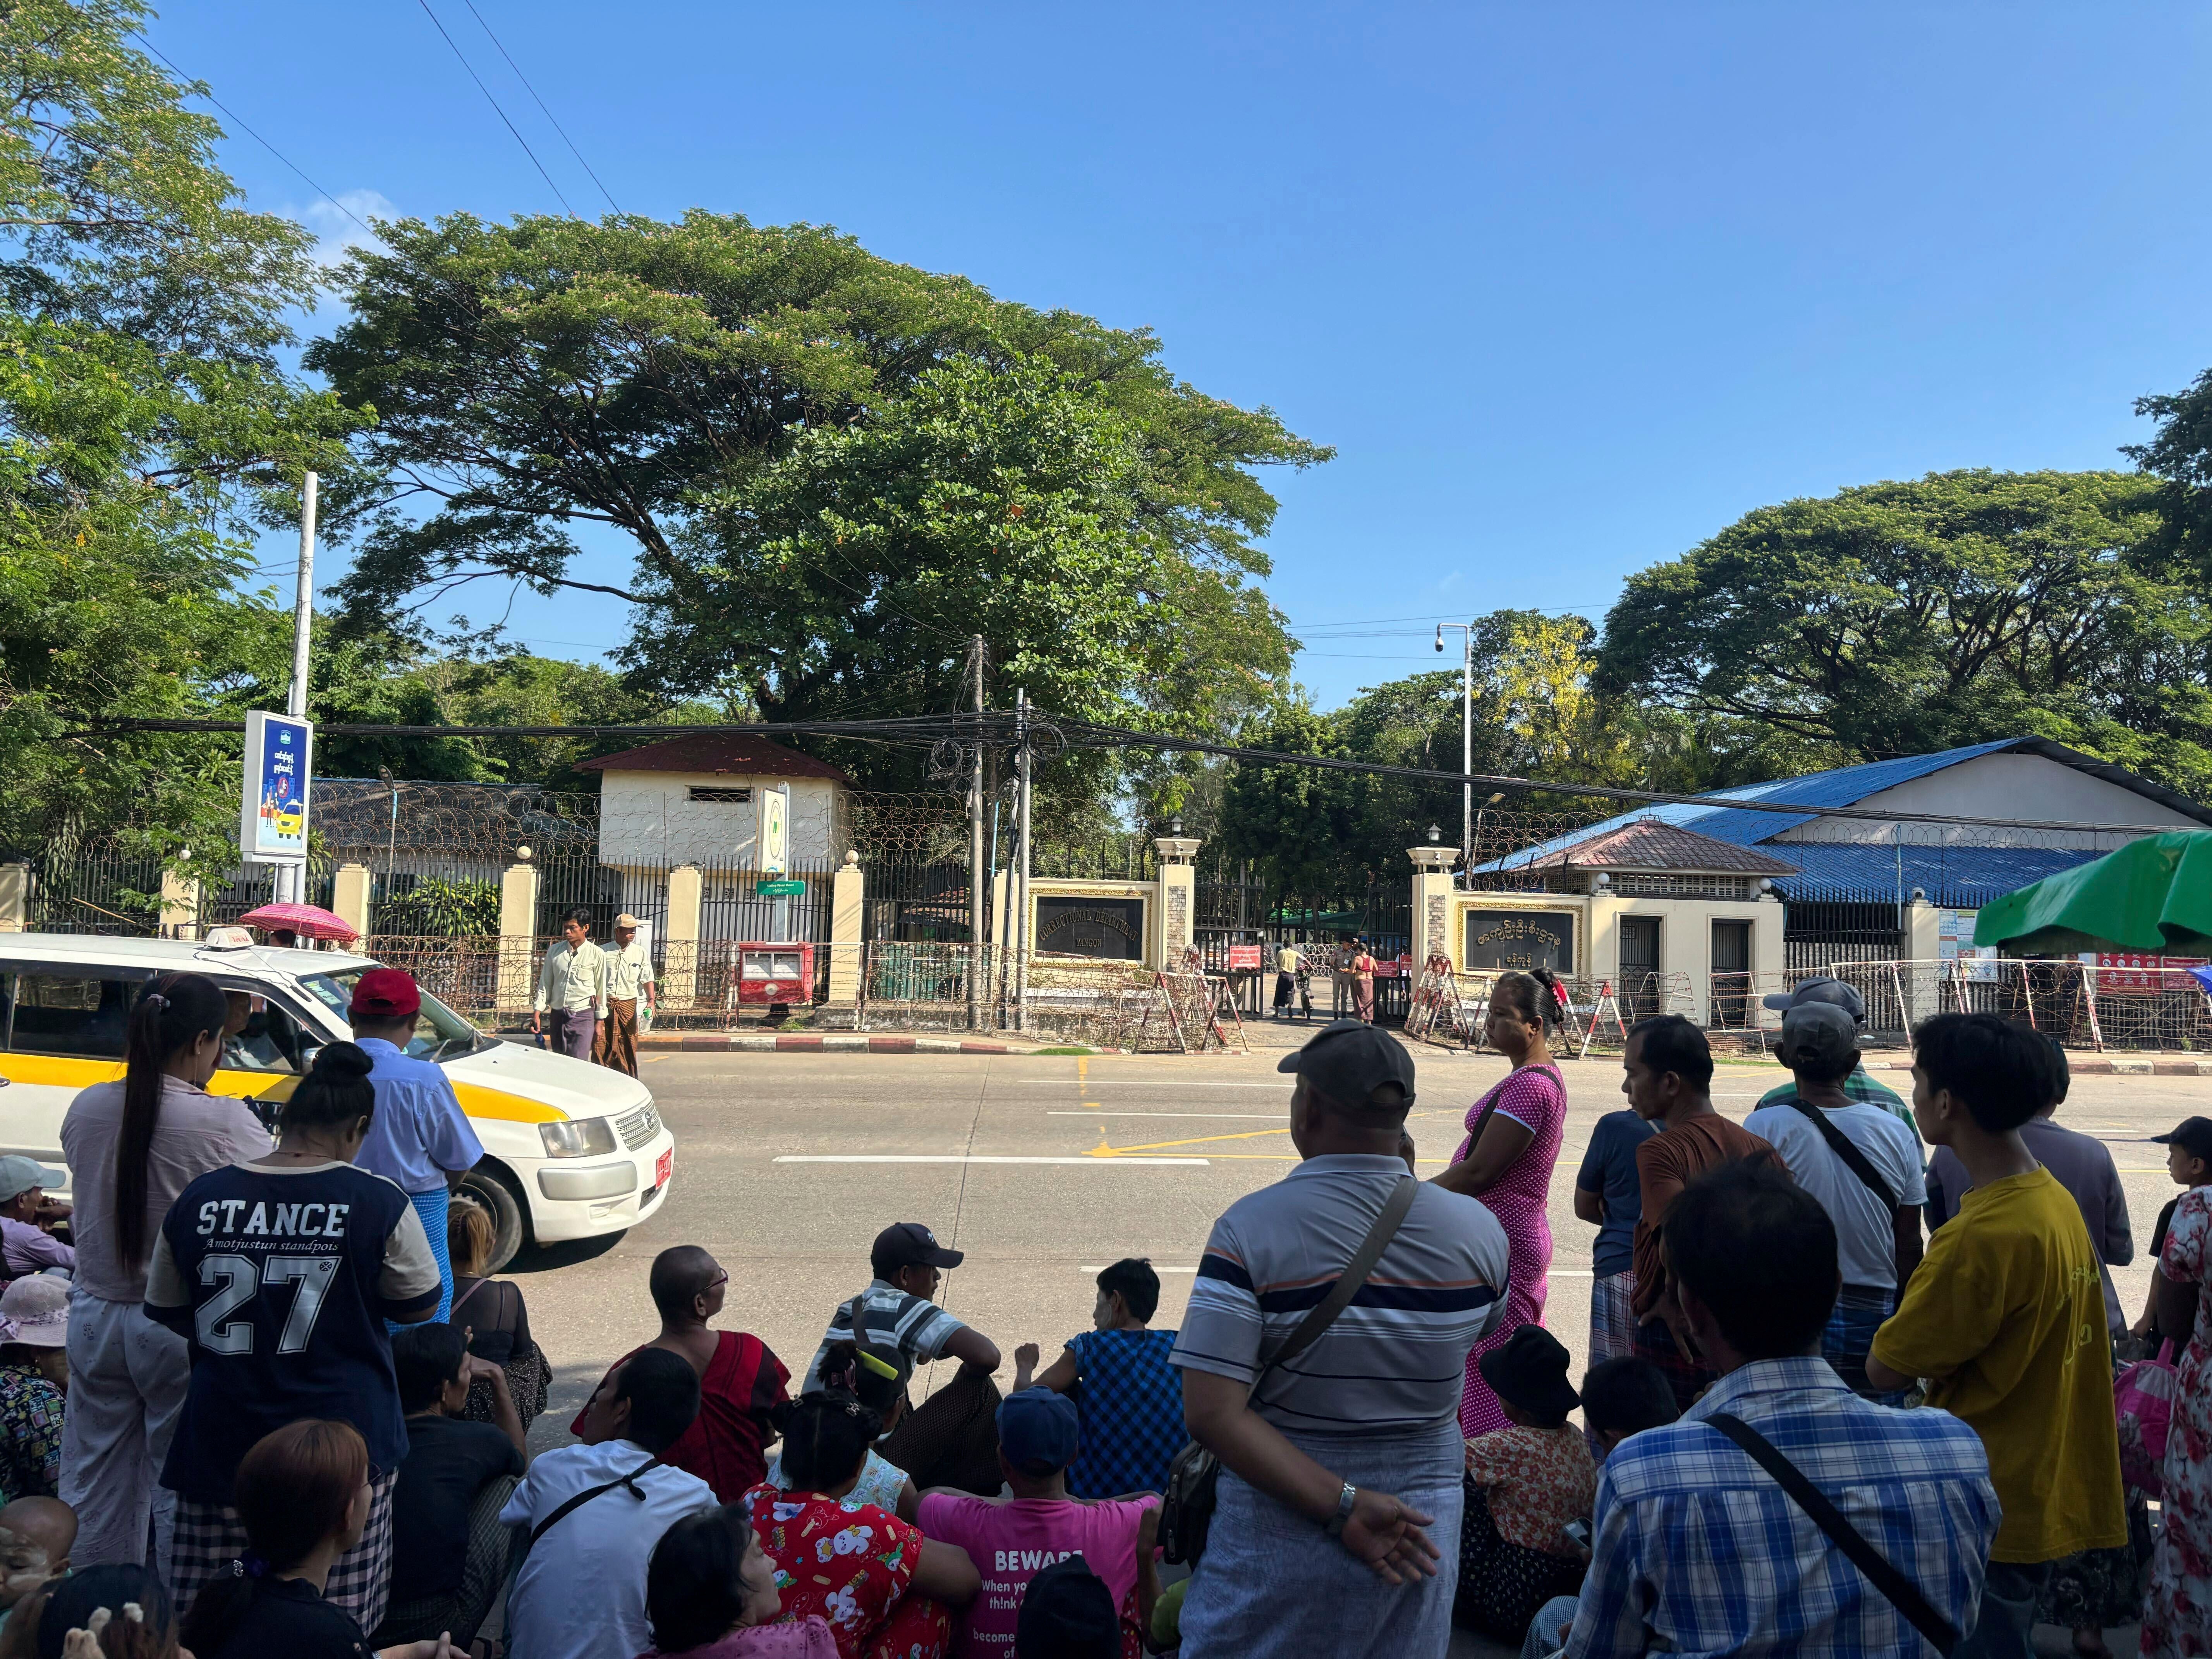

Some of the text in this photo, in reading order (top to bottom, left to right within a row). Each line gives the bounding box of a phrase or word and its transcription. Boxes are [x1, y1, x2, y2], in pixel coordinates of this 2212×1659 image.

[1039, 910, 1139, 941] CORRECTIONAL DEPARTMENT
[1075, 938, 1101, 948] YANGON
[196, 1200, 350, 1237] STANCE
[203, 1238, 339, 1254] Amotjustun standpois
[195, 1253, 342, 1355] 27
[995, 1550, 1082, 1571] BEWAR
[982, 1579, 1027, 1595] When yo
[973, 1627, 1015, 1642] become
[1004, 1646, 1015, 1659] of
